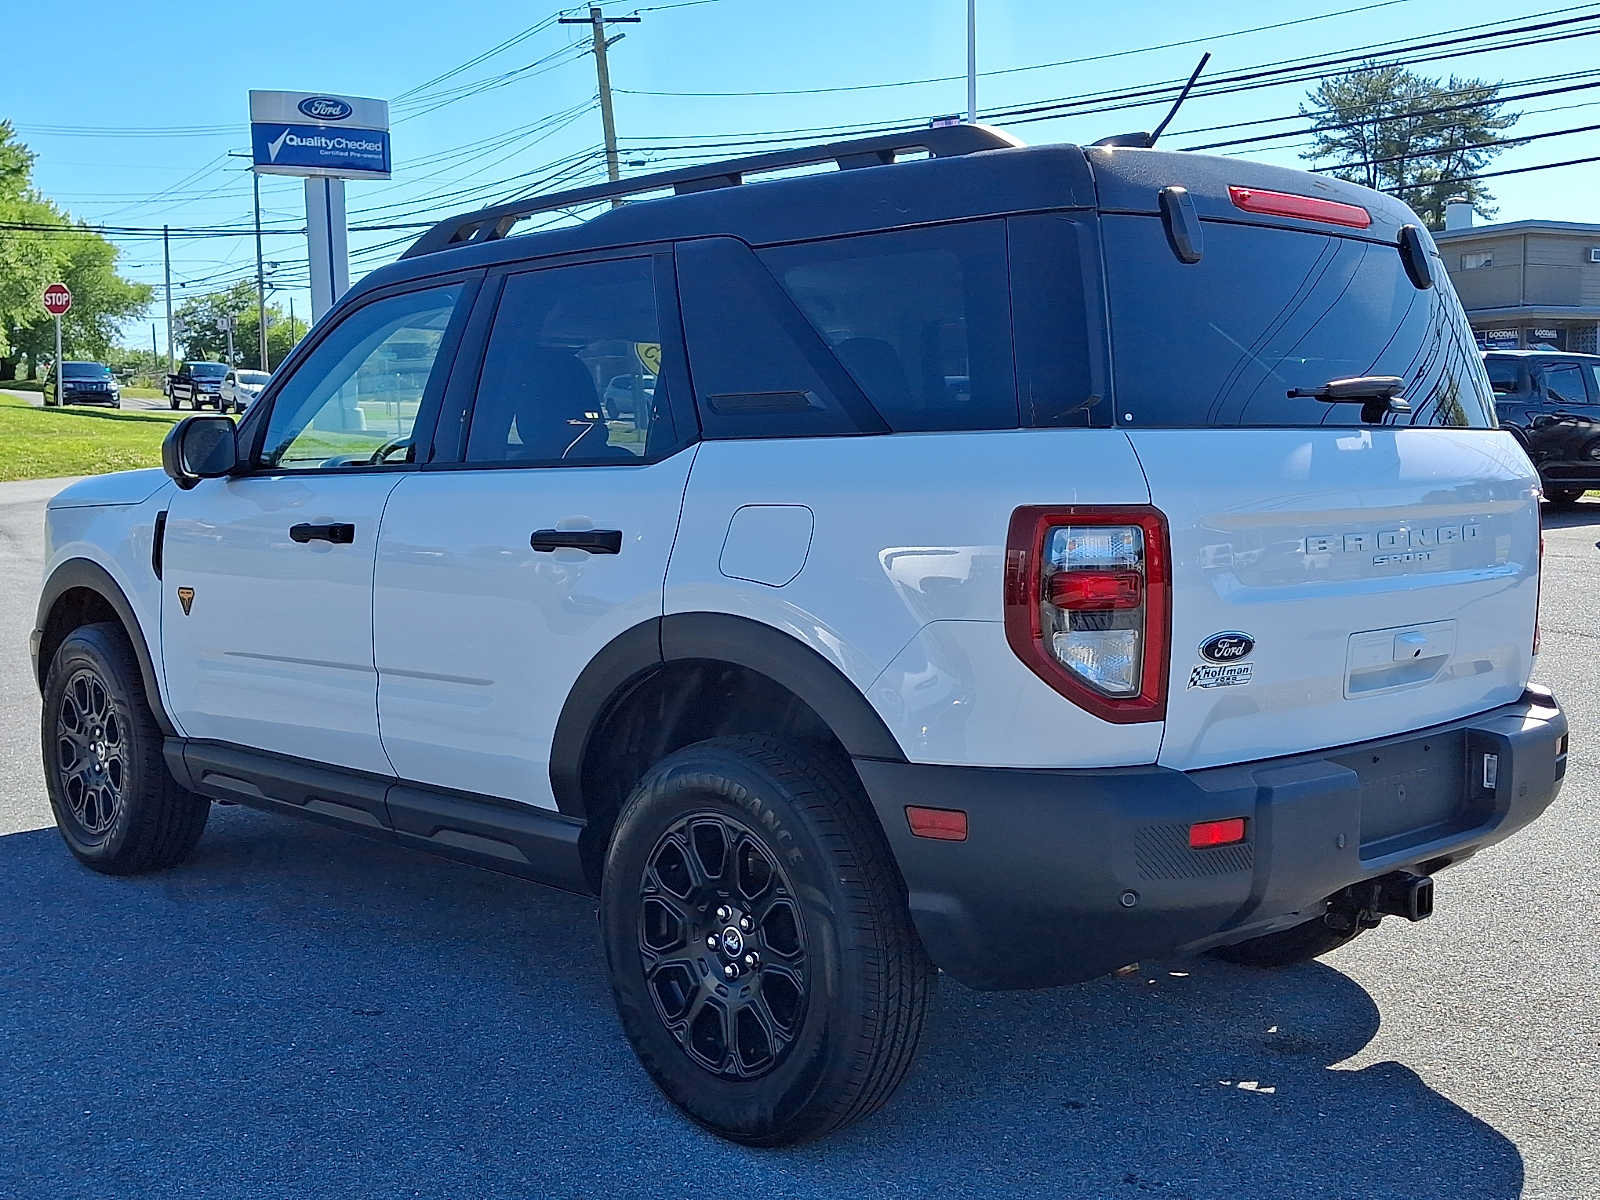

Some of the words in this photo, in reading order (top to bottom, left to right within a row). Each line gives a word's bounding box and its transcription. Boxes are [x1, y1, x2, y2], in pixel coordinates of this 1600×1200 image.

[311, 100, 342, 116] Ford
[285, 134, 382, 151] QualityChecked
[45, 292, 69, 306] STOP
[1305, 523, 1481, 556] BRONCO
[1372, 551, 1432, 567] SPORT
[1214, 638, 1246, 658] Ford
[1203, 666, 1249, 677] Hoffman
